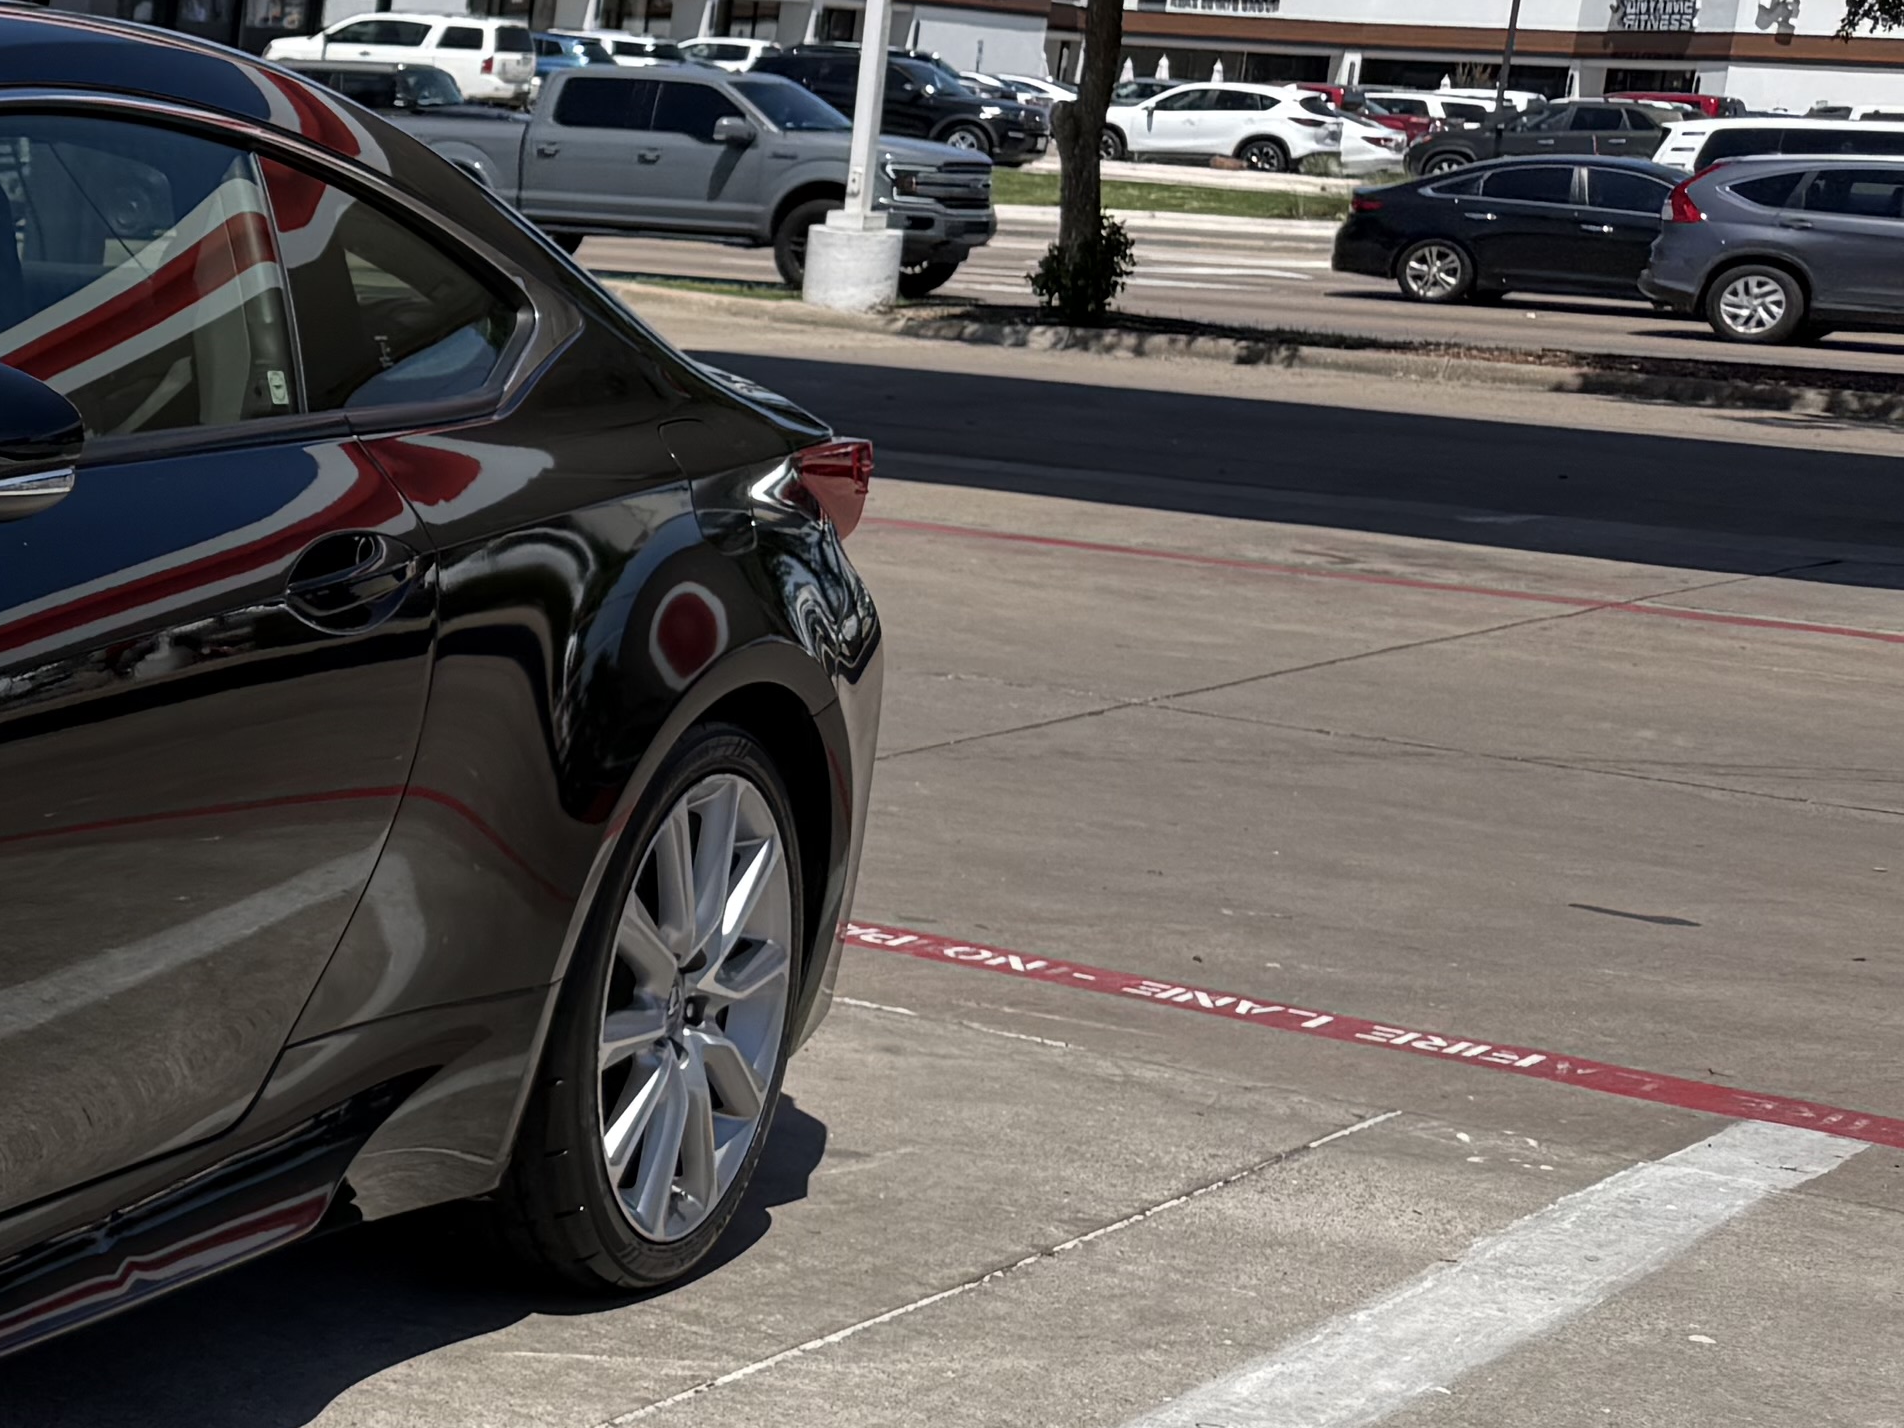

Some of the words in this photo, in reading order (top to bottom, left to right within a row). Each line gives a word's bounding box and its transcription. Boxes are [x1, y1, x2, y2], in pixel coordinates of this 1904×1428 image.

[1623, 14, 1695, 31] FITNESS
[942, 944, 1050, 972] NO
[1121, 979, 1334, 1030] LANE
[1354, 1023, 1547, 1068] FIRE
